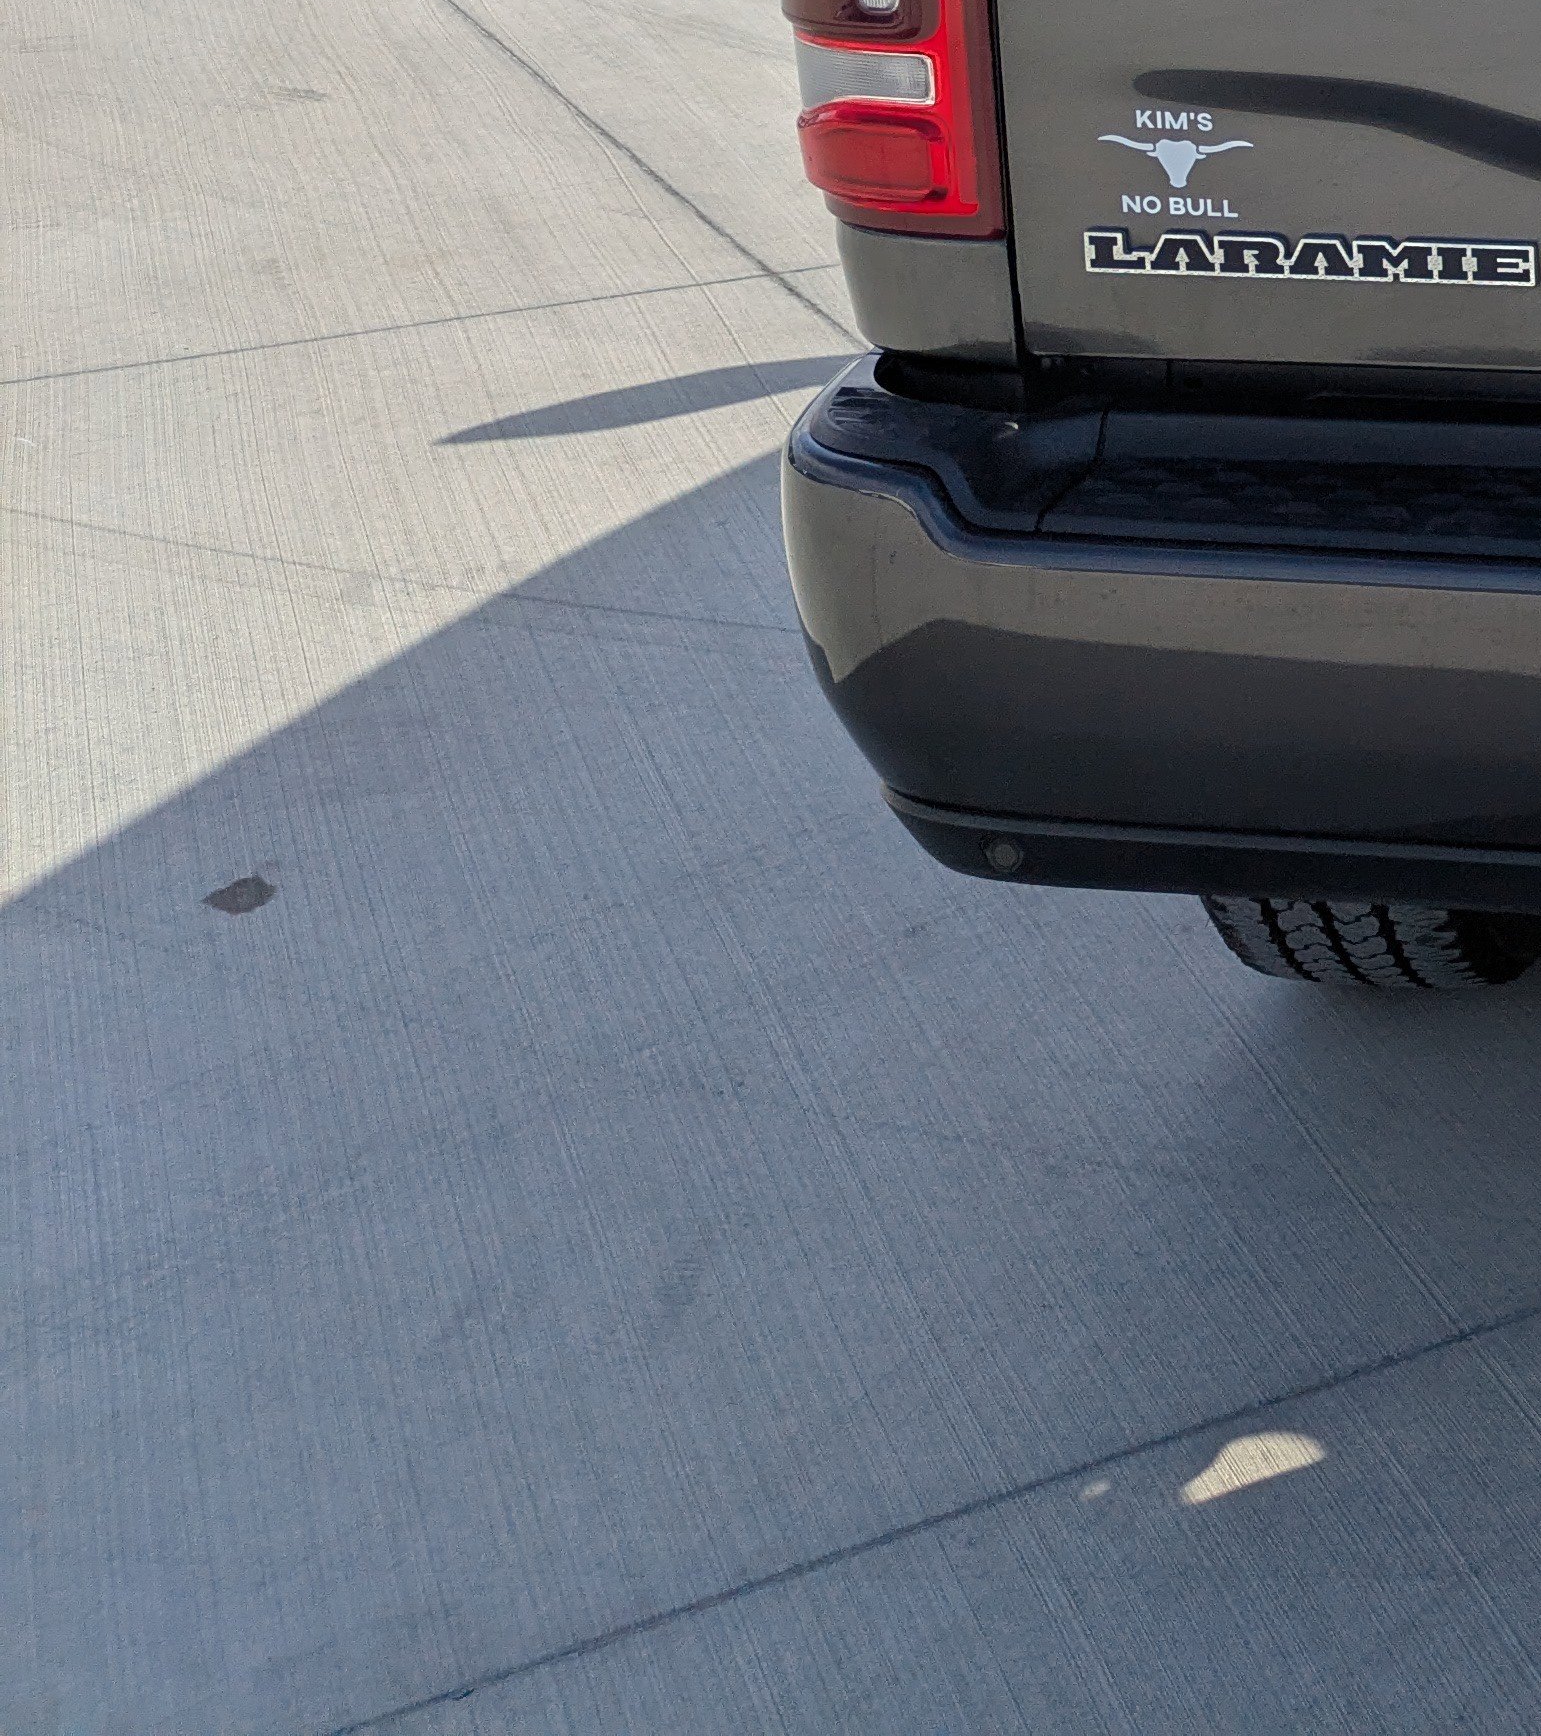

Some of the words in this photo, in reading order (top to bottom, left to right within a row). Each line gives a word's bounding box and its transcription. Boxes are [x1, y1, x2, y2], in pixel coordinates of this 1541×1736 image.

[1134, 109, 1213, 132] KIM'S
[1121, 194, 1162, 215] NO
[1169, 197, 1239, 219] BULL
[1083, 226, 1540, 288] LARAMIE
